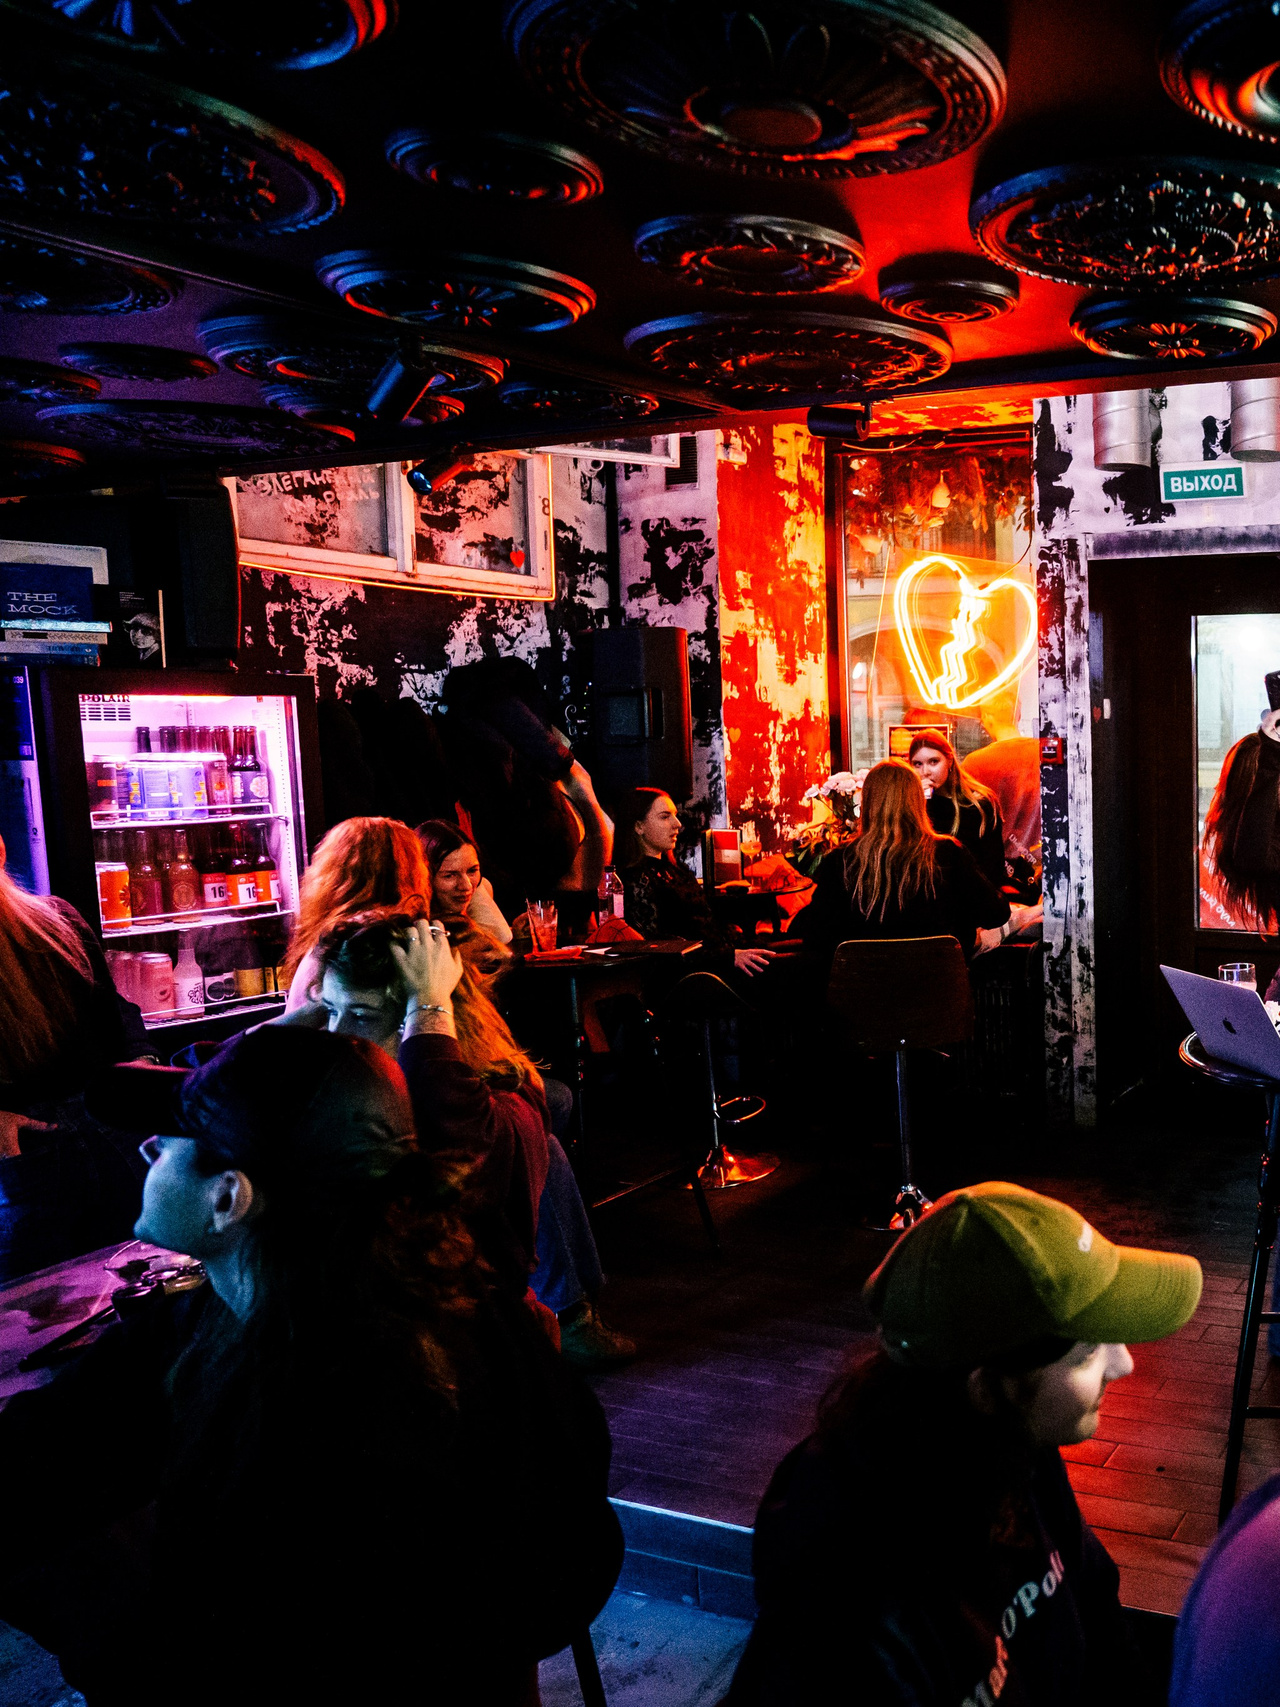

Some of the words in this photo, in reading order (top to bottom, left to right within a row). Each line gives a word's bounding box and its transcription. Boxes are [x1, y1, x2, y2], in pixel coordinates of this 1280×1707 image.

[1170, 473, 1238, 493] ВЫХОД
[7, 591, 58, 603] THE
[7, 603, 79, 616] MOCK
[80, 694, 131, 703] POLAIR
[211, 886, 225, 899] 16
